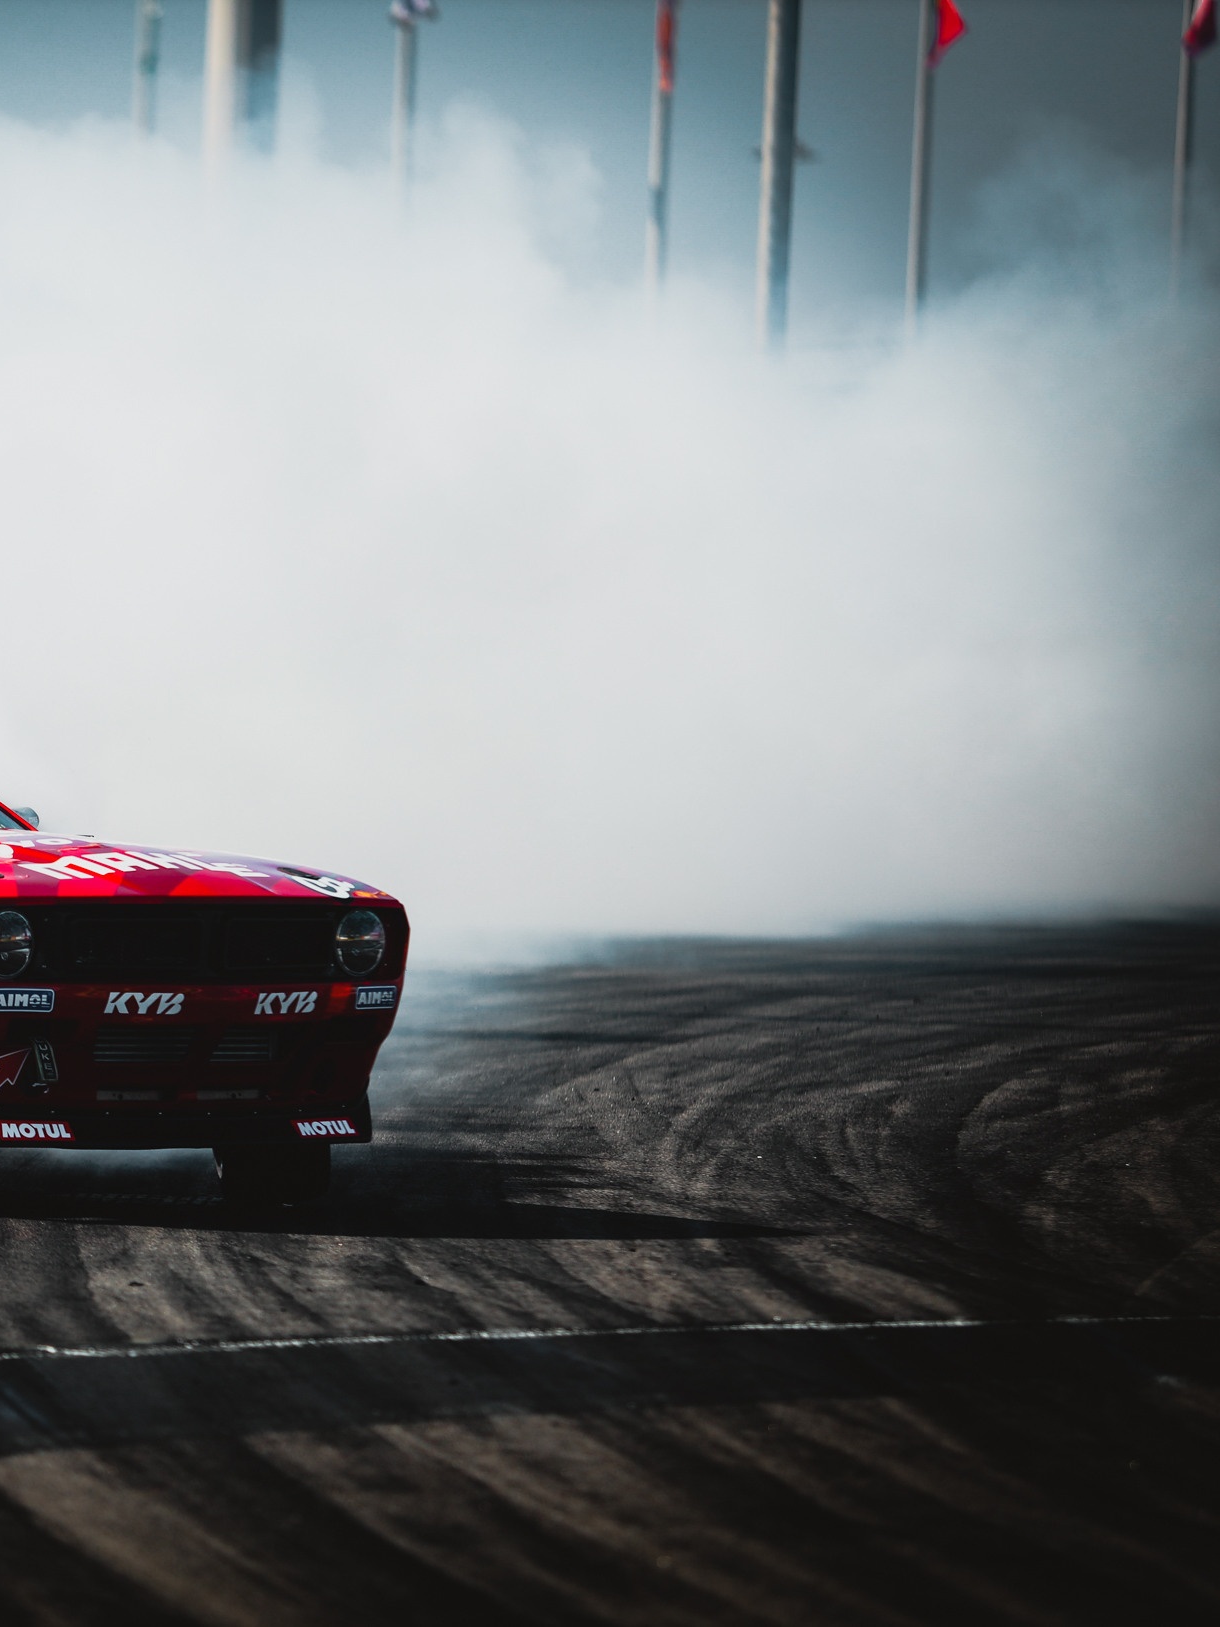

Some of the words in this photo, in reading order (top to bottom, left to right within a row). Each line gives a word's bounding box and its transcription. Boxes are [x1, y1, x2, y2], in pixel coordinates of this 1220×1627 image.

[103, 991, 185, 1015] KYB
[253, 991, 319, 1015] KYB
[0, 1122, 72, 1139] MOTUL
[296, 1119, 356, 1136] MOTUL
